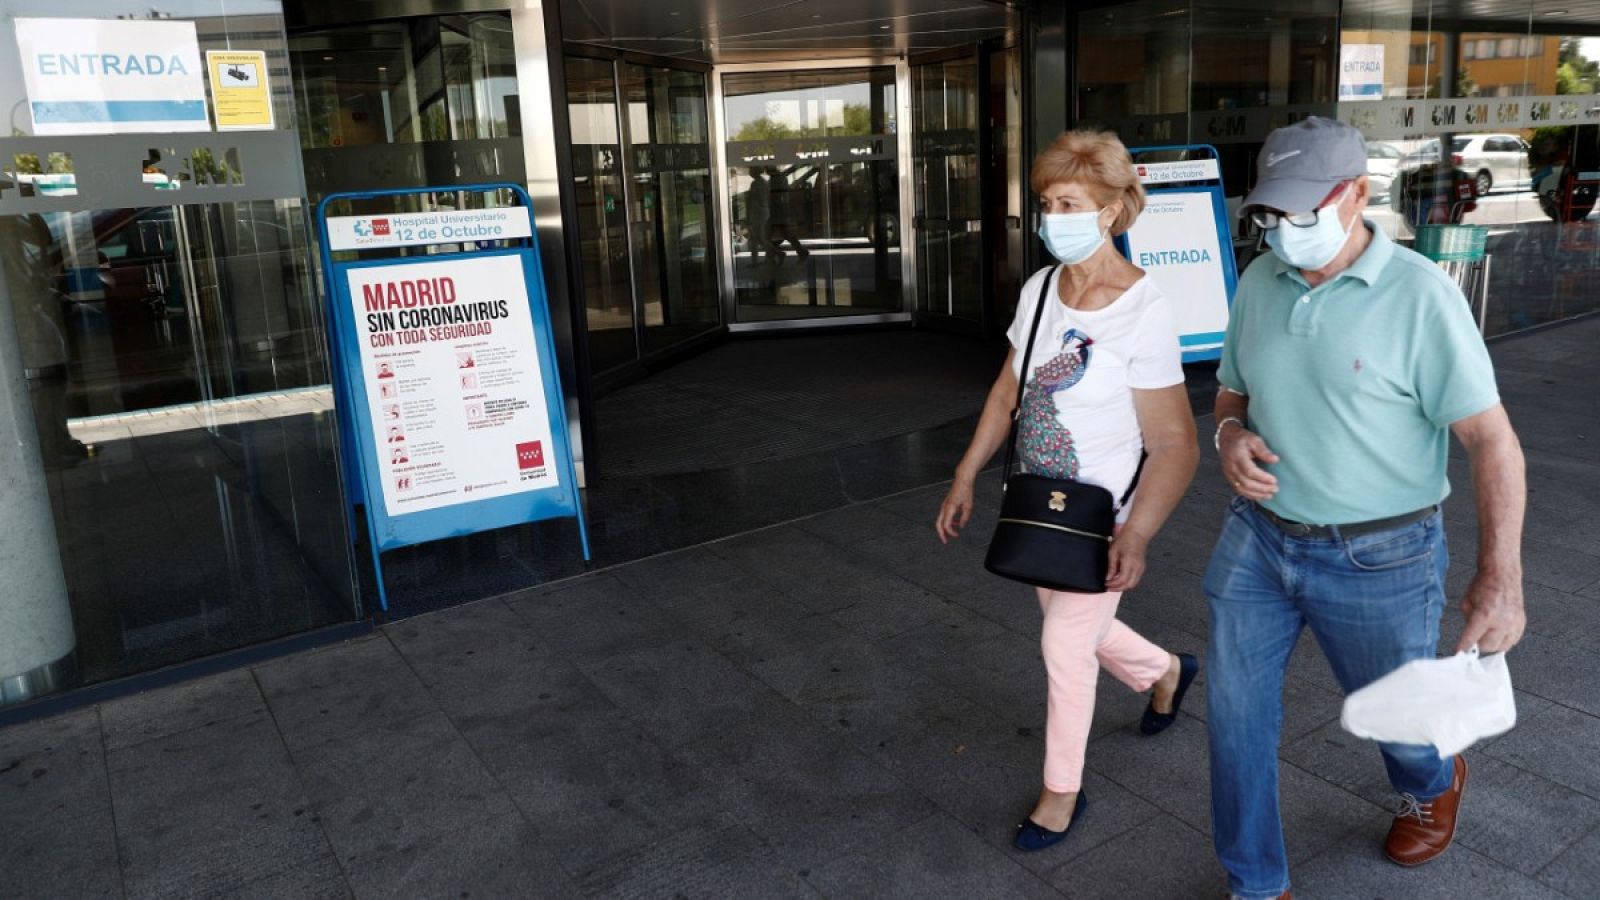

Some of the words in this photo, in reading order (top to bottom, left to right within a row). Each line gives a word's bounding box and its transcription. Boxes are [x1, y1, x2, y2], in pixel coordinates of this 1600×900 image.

[38, 54, 188, 75] ENTRADA
[1343, 60, 1381, 73] ENTRADA
[1160, 171, 1170, 179] de
[1172, 169, 1205, 179] Octubre
[393, 214, 438, 227] Hospital
[440, 212, 507, 225] Universitario
[395, 229, 414, 241] 12
[418, 226, 437, 240] de
[440, 223, 503, 238] Octubre
[1140, 249, 1211, 267] ENTRADA
[362, 277, 456, 311] MADRID
[367, 312, 396, 333] SIN
[399, 299, 509, 329] CORONAVIRUS
[370, 333, 394, 348] CON
[396, 328, 428, 345] TODA
[429, 321, 492, 341] SEGURIDAD
